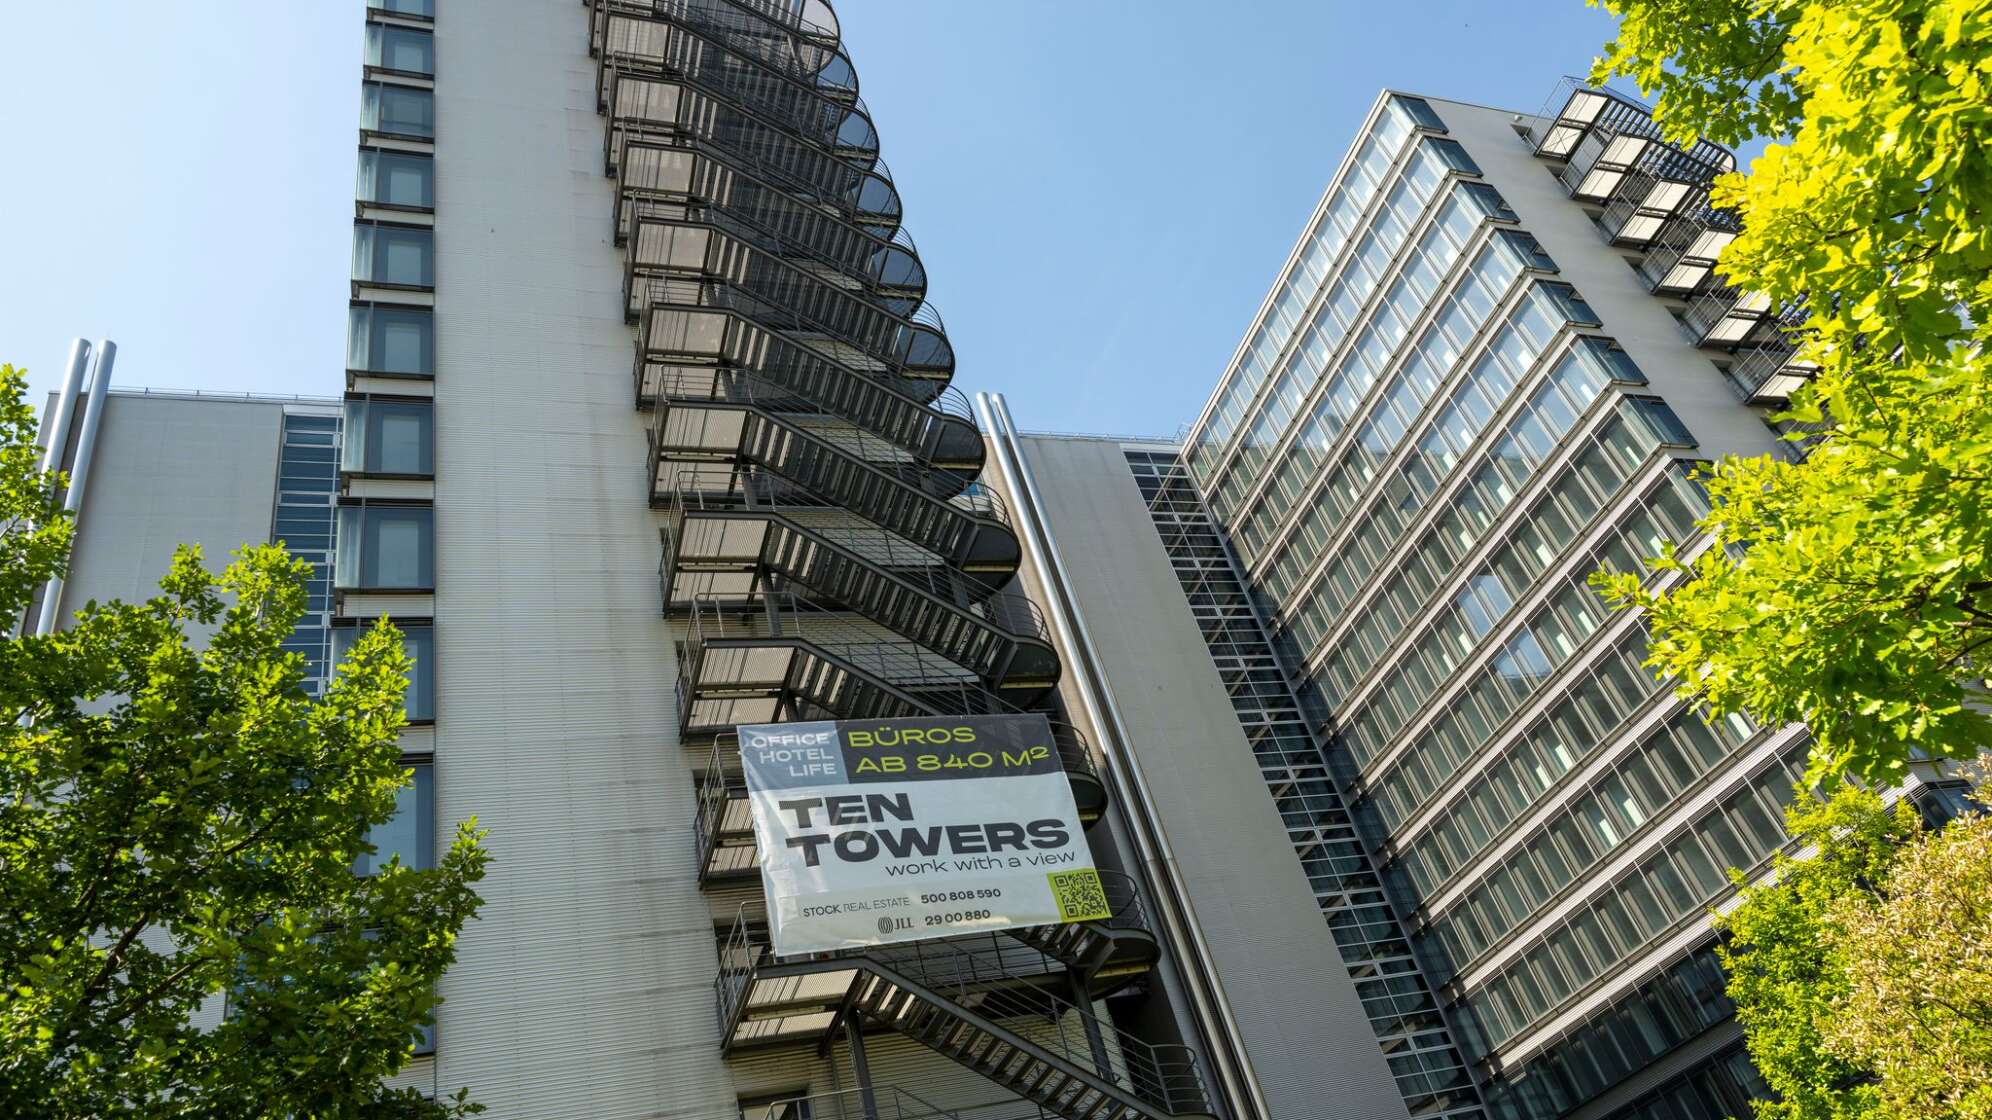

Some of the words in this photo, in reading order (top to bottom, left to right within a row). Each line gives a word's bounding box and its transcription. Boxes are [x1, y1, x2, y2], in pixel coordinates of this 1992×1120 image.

[751, 732, 830, 748] OFFICE
[848, 726, 976, 747] BÜROS
[760, 748, 834, 764] HOTEL
[856, 756, 907, 773] AB
[916, 751, 993, 771] 840
[789, 763, 837, 777] LIFE
[778, 793, 915, 829] TEN
[785, 819, 1070, 867] TOWERS
[884, 859, 948, 877] work
[953, 855, 1003, 872] with
[1007, 857, 1021, 868] a
[1026, 850, 1076, 865] view
[921, 892, 947, 904] 500
[976, 888, 1001, 899] 590
[803, 904, 841, 918] STOCK
[842, 903, 872, 913] REAL
[873, 897, 911, 910] ESTATE
[894, 917, 915, 930] JLL
